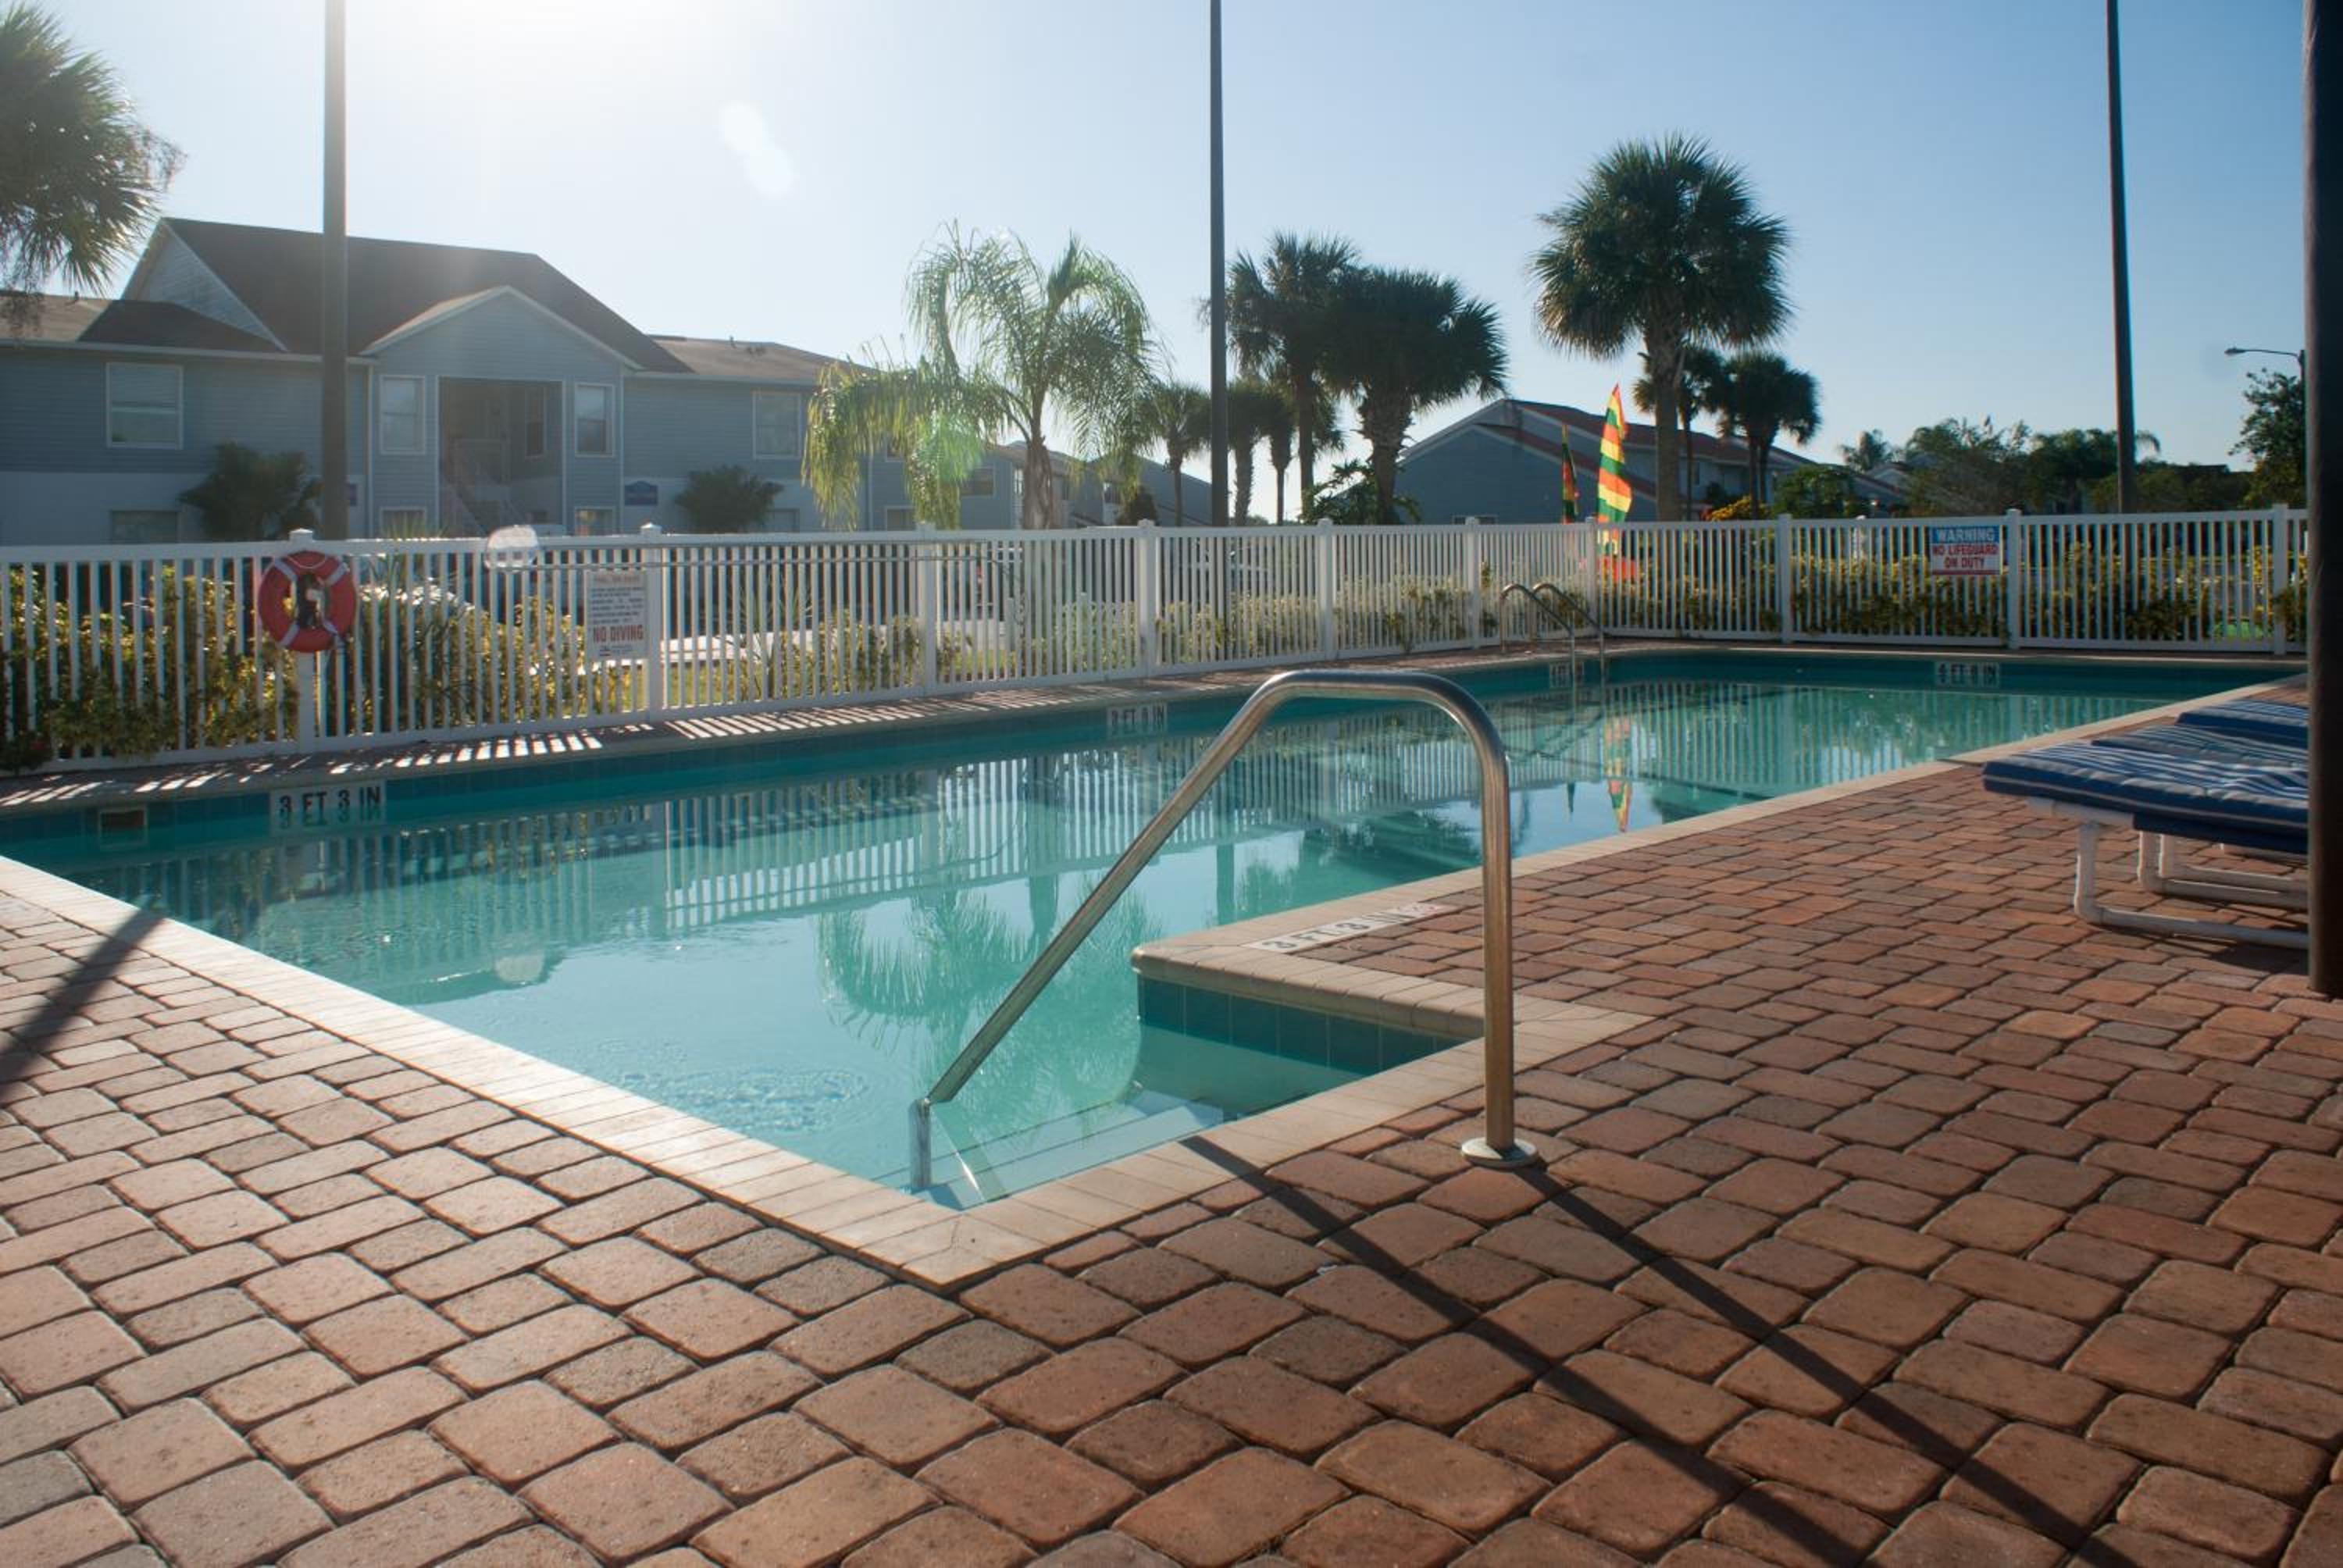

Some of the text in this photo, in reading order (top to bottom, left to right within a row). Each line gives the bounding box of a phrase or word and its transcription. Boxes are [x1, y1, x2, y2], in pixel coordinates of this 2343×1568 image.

[1937, 528, 1995, 543] WARNING
[1933, 544, 1997, 555] NO LIFEGUARD
[1945, 557, 1985, 568] ON DUTY
[593, 624, 644, 643] NO DIVING
[278, 786, 381, 815] 3 FT 3 IN
